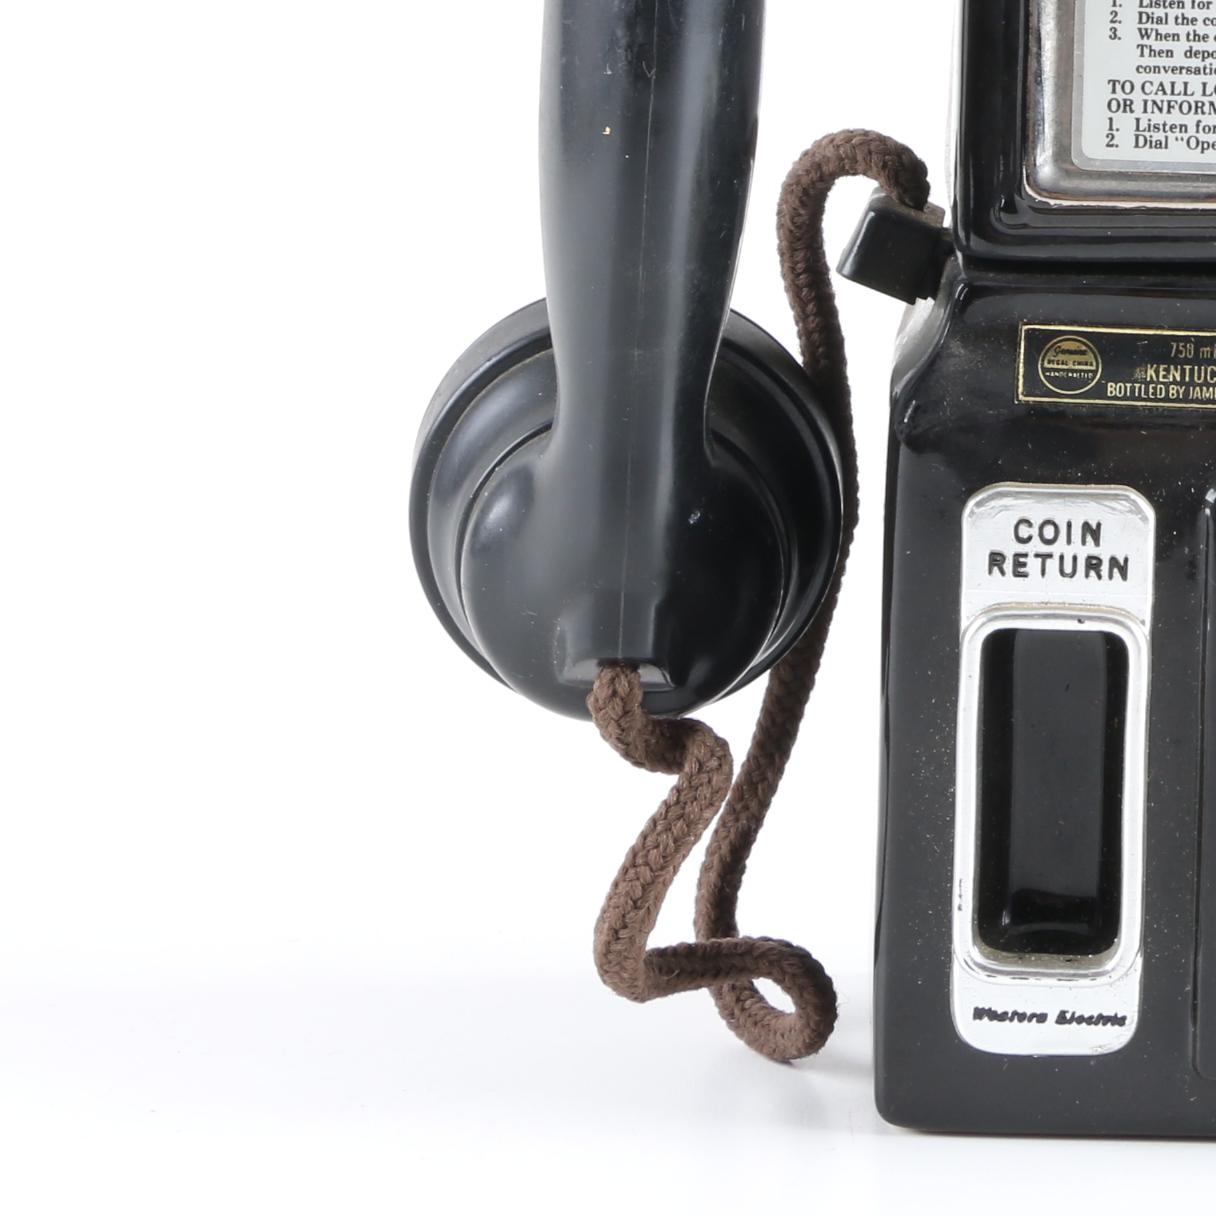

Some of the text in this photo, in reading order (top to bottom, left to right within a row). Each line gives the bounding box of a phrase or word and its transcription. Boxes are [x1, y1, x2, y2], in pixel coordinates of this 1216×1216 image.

[1109, 11, 1122, 24] 2.
[1137, 12, 1168, 26] Dial
[1174, 13, 1198, 26] the
[1109, 28, 1121, 40] 3.
[1137, 28, 1180, 42] When
[1186, 29, 1209, 43] the
[1137, 44, 1174, 59] Then
[1108, 80, 1134, 95] TO
[1141, 81, 1195, 97] CALL
[1107, 98, 1134, 114] OR
[1107, 118, 1120, 132] 1.
[1134, 119, 1188, 134] Listen
[1105, 134, 1119, 148] 2.
[1134, 134, 1168, 150] Dial
[1170, 342, 1193, 359] 750
[1107, 382, 1165, 399] BOTTLED
[1169, 385, 1185, 399] BY
[1013, 518, 1102, 547] COIN
[988, 551, 1129, 581] RETURN
